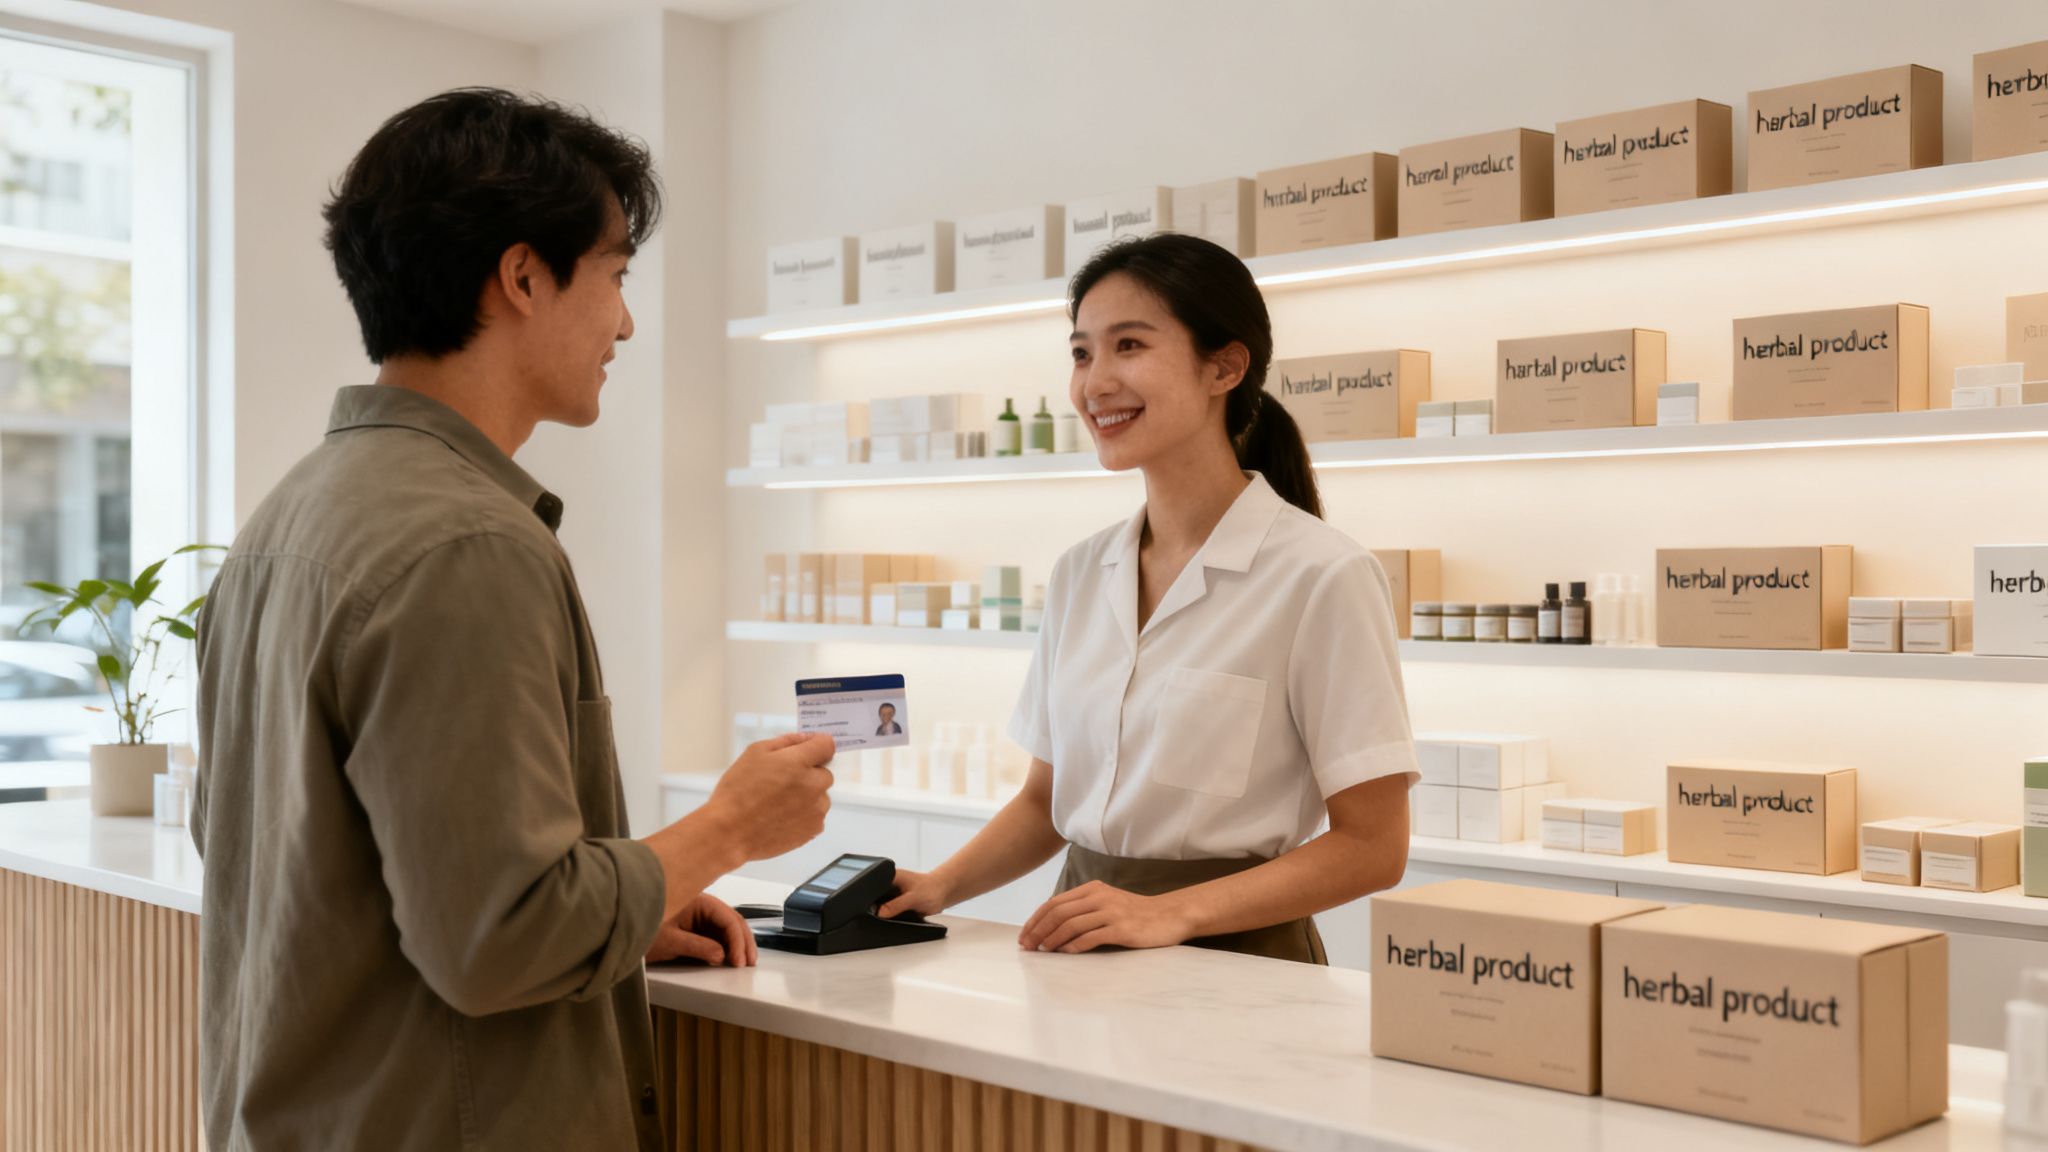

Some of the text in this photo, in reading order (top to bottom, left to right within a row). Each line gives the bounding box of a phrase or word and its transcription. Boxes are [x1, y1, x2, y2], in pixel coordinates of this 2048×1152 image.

[1822, 93, 1901, 131] product
[1810, 329, 1889, 361] product
[1666, 566, 1810, 596] herbal product
[1990, 569, 2048, 594] herb
[1678, 782, 1738, 809] herbal
[1387, 933, 1574, 990] herbal product
[1623, 965, 1840, 1028] herbal product
